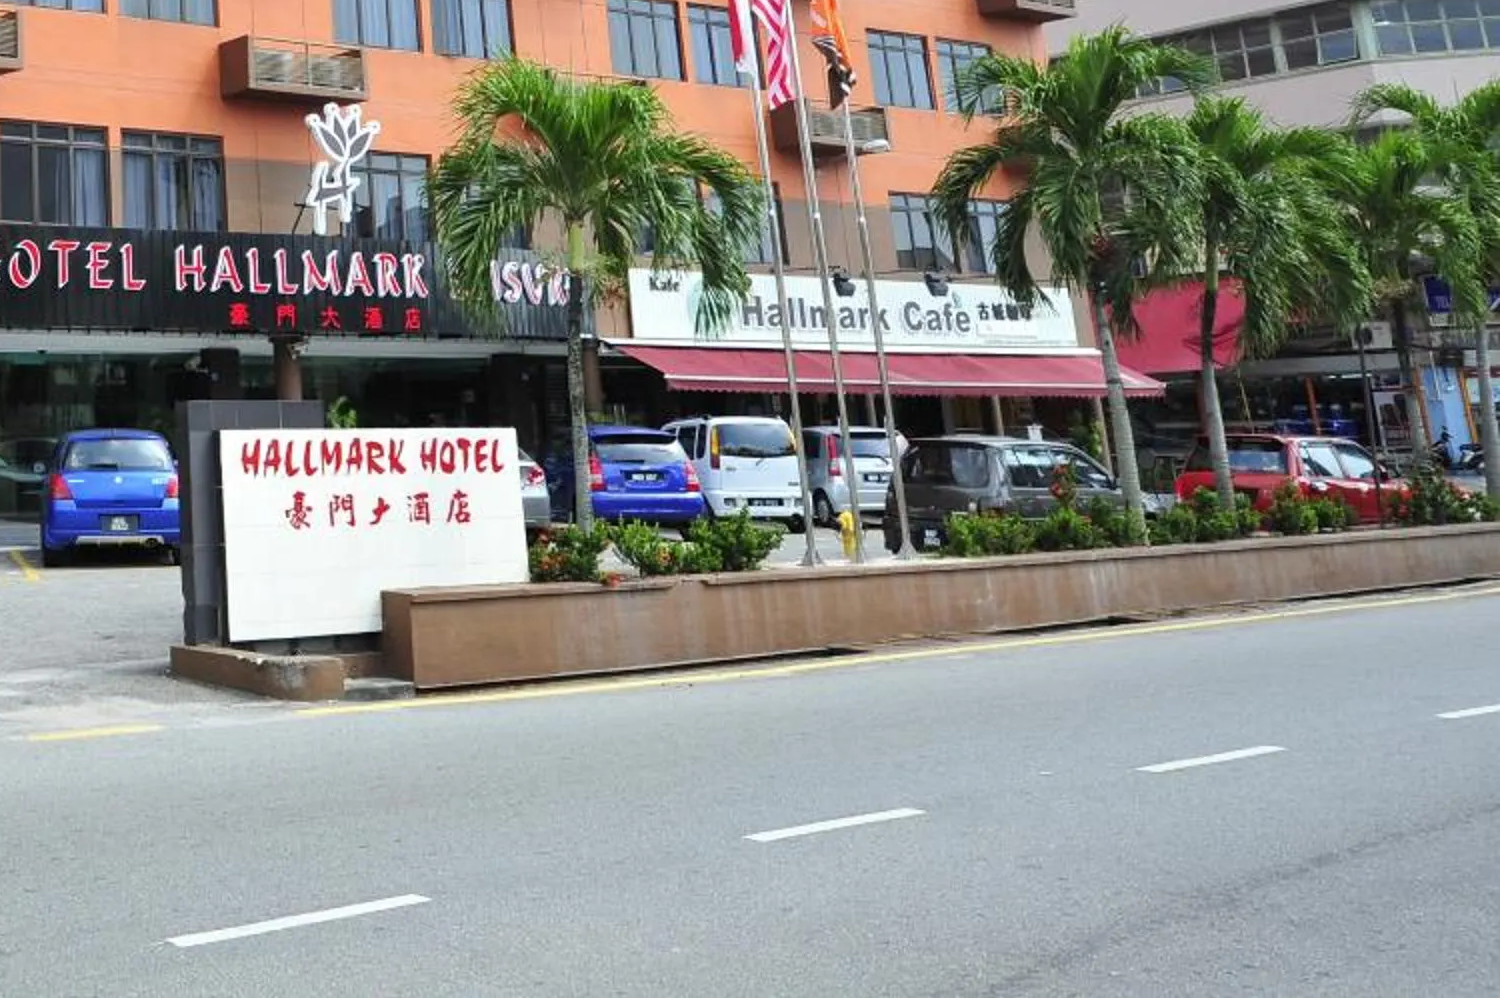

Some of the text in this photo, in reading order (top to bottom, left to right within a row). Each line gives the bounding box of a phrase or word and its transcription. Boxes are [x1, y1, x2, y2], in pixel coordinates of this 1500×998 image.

[174, 244, 428, 299] HALLMARK
[241, 437, 504, 477] HALLMARK HOTEL
